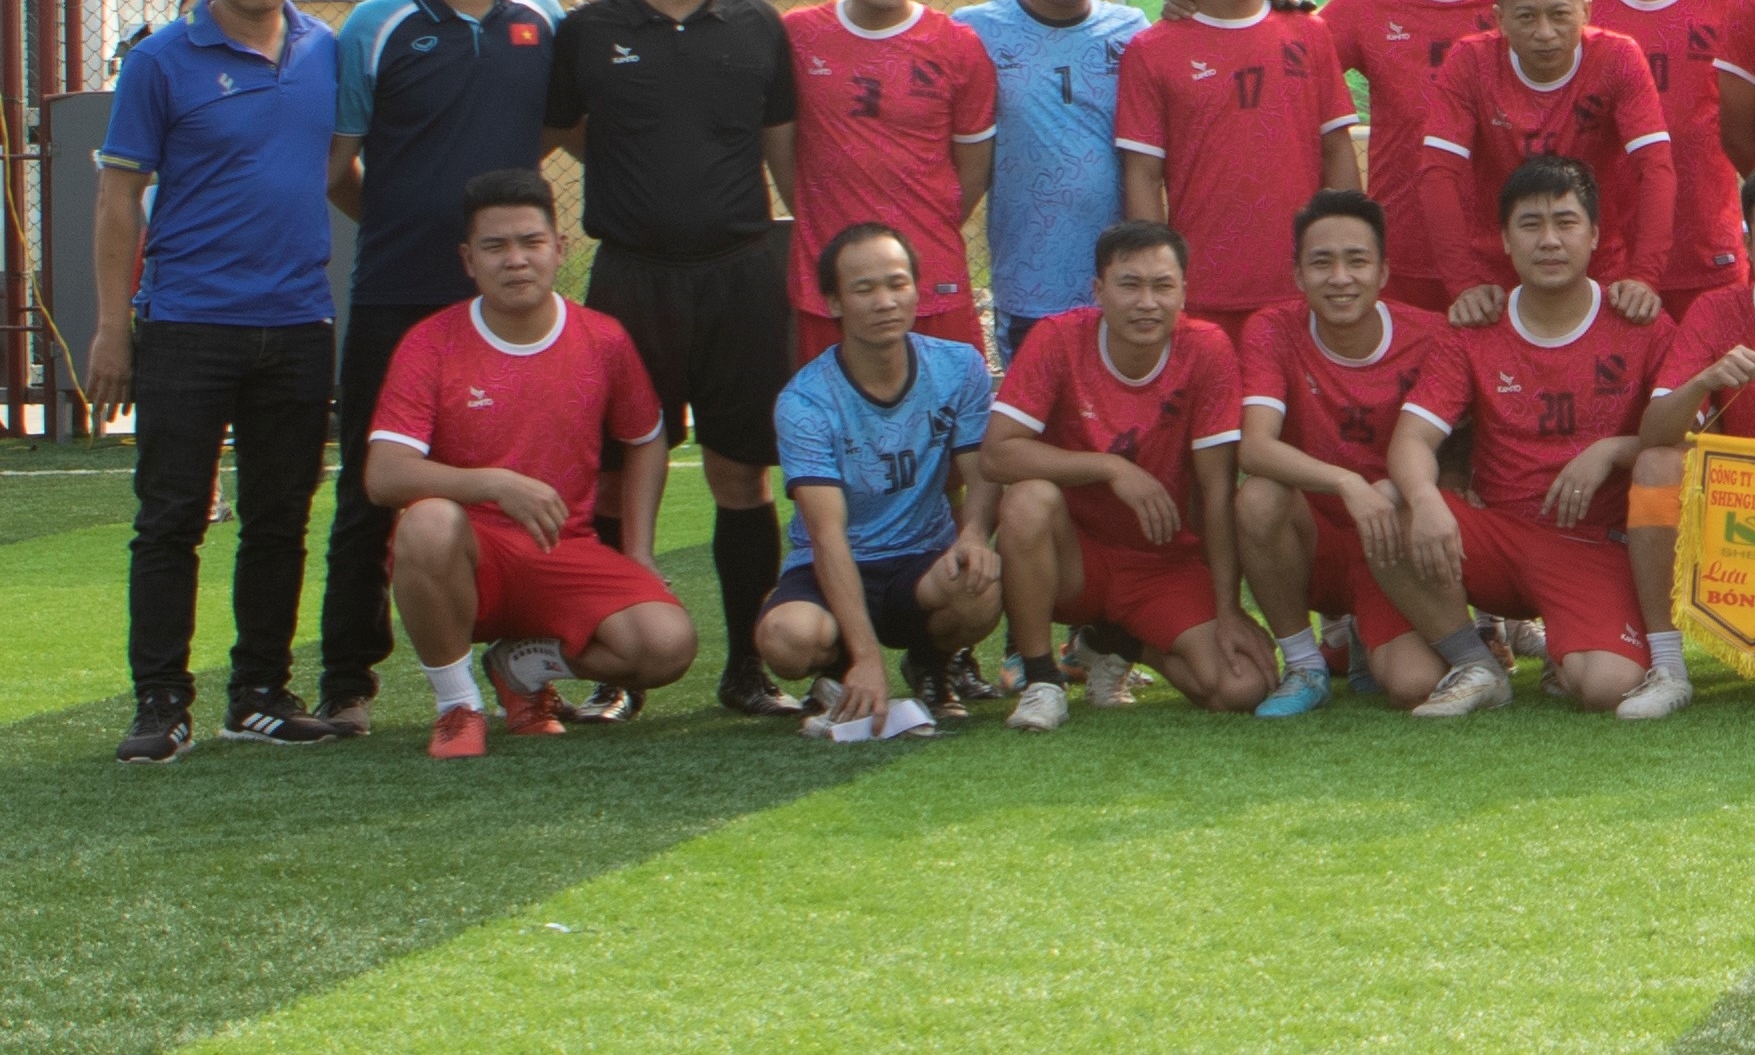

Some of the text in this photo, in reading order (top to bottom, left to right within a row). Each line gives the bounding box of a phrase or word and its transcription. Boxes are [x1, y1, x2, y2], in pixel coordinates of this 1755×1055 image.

[1055, 65, 1074, 105] 1
[1234, 65, 1265, 109] 17
[1539, 392, 1575, 437] 20
[878, 449, 918, 497] 30
[1710, 464, 1738, 485] CÔNG
[1740, 471, 1753, 487] TY
[1702, 561, 1748, 585] Lưu
